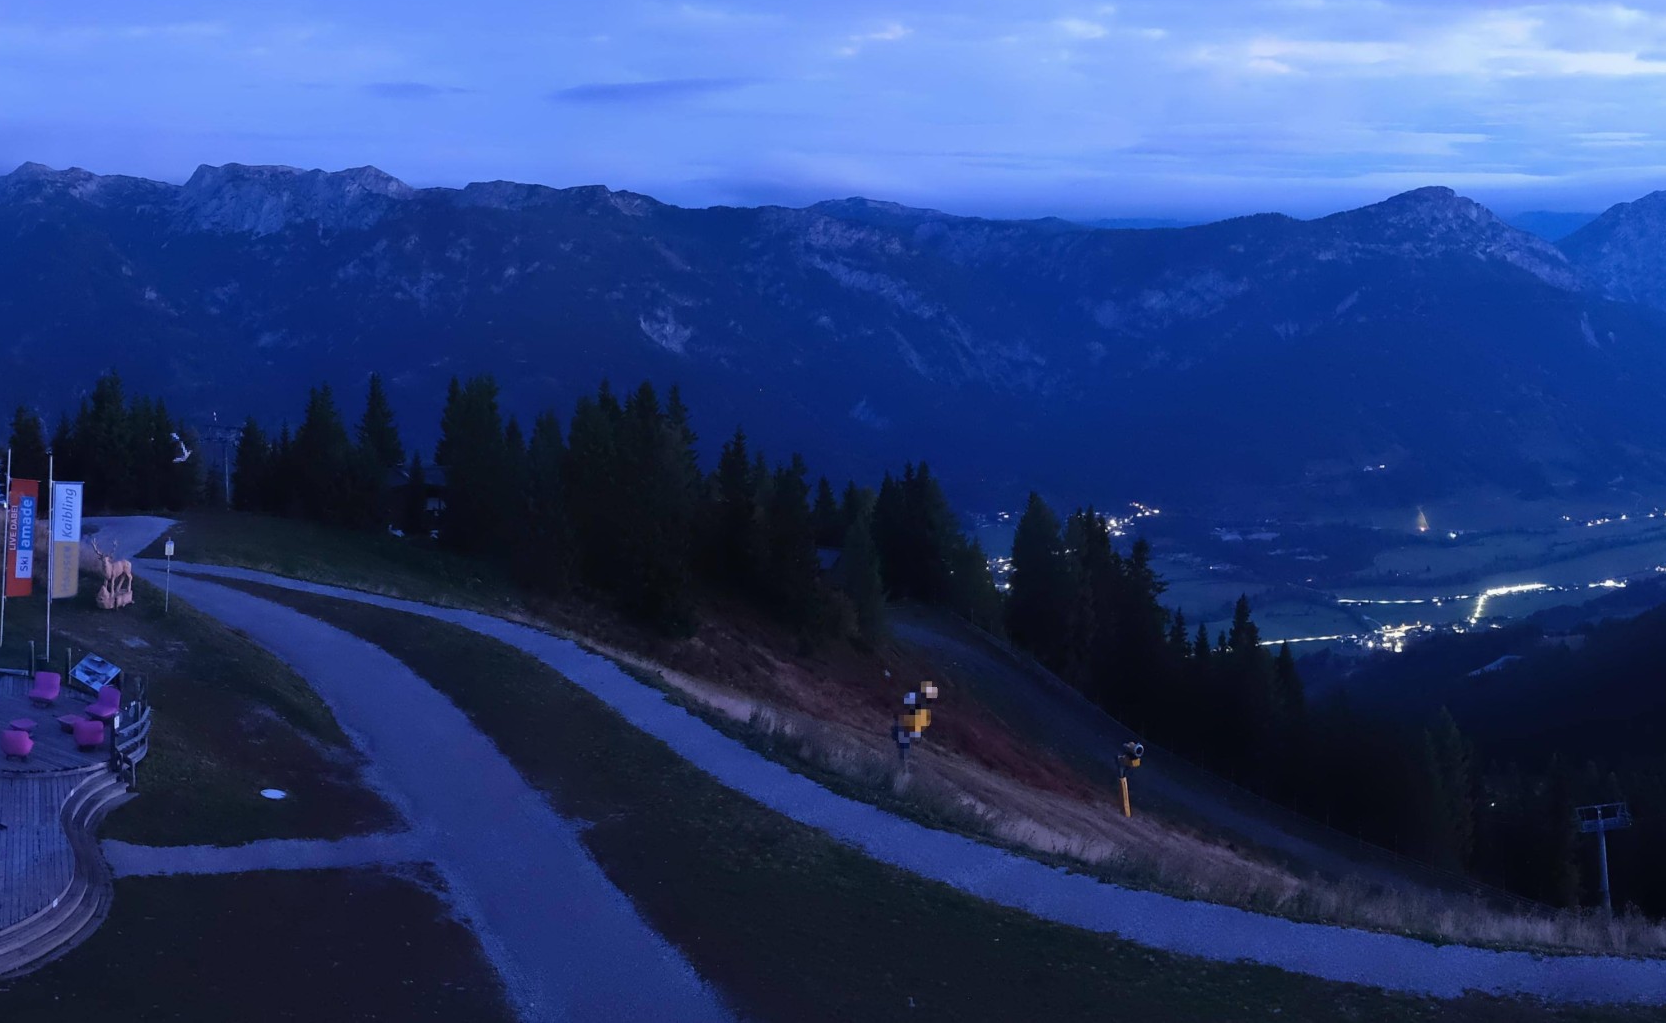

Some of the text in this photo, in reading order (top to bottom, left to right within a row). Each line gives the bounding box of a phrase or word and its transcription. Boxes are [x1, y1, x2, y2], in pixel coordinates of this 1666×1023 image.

[9, 505, 19, 551] LIVE DABEI
[61, 488, 77, 539] Kaibling
[19, 556, 29, 572] Ski
